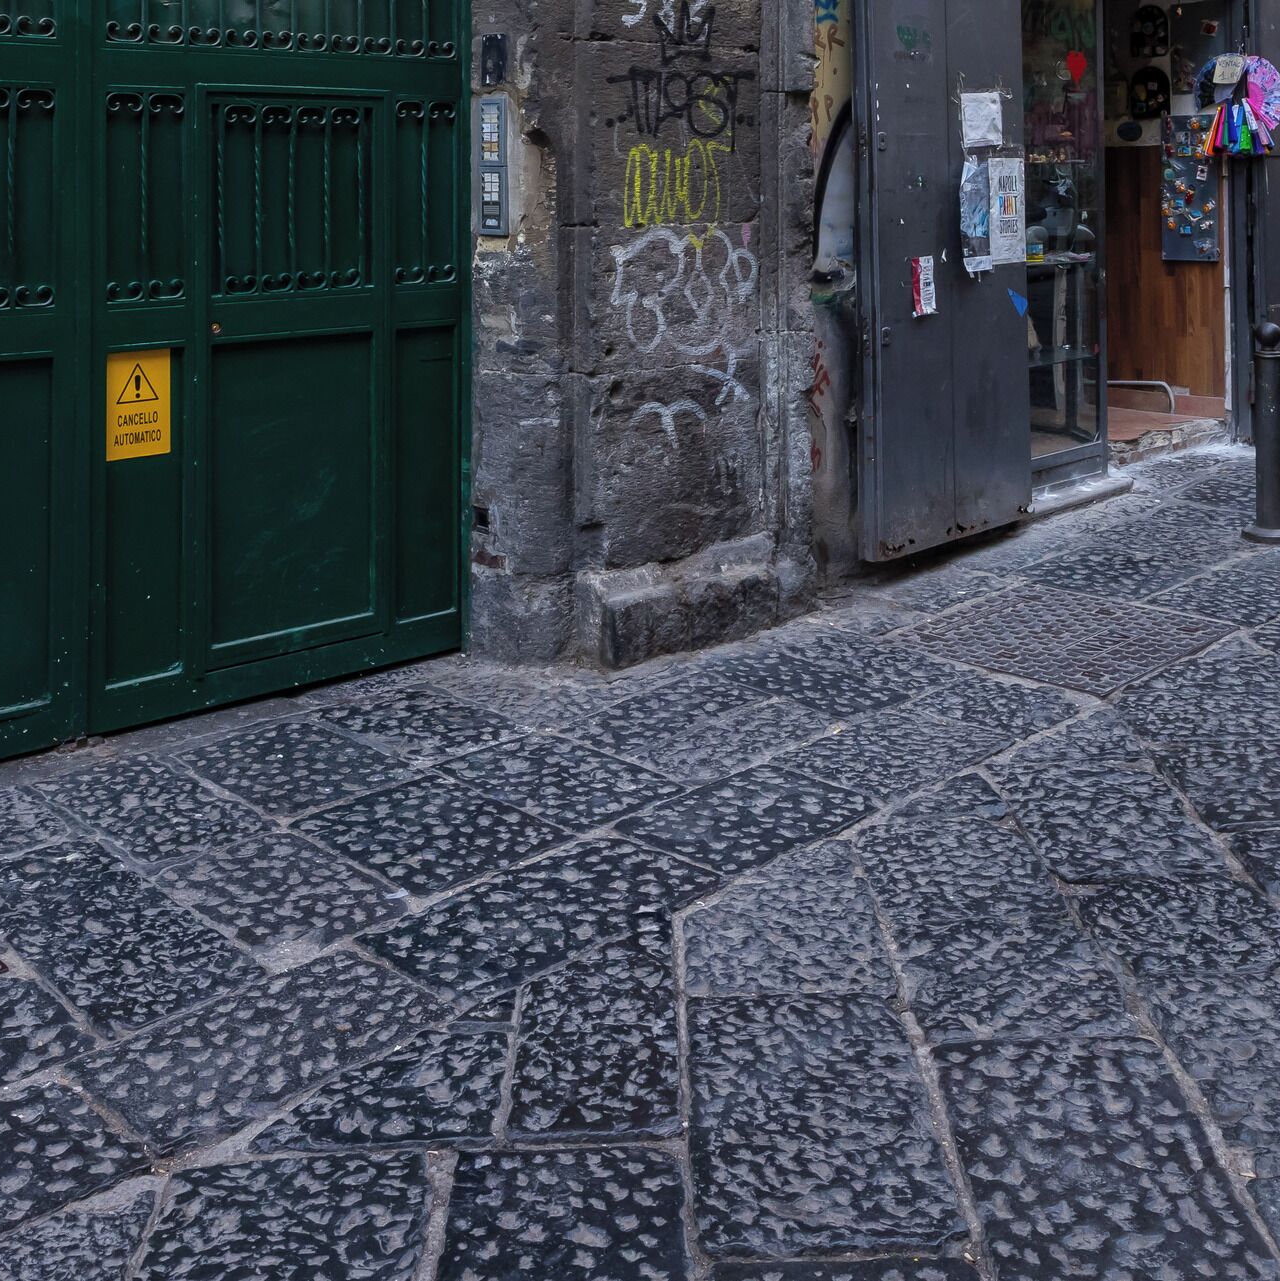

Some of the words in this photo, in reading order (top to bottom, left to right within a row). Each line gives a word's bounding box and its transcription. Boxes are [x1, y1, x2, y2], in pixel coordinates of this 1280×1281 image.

[998, 195, 1018, 216] PAINT
[118, 411, 158, 427] CANCELLO
[114, 429, 161, 446] AUTOMATICO
